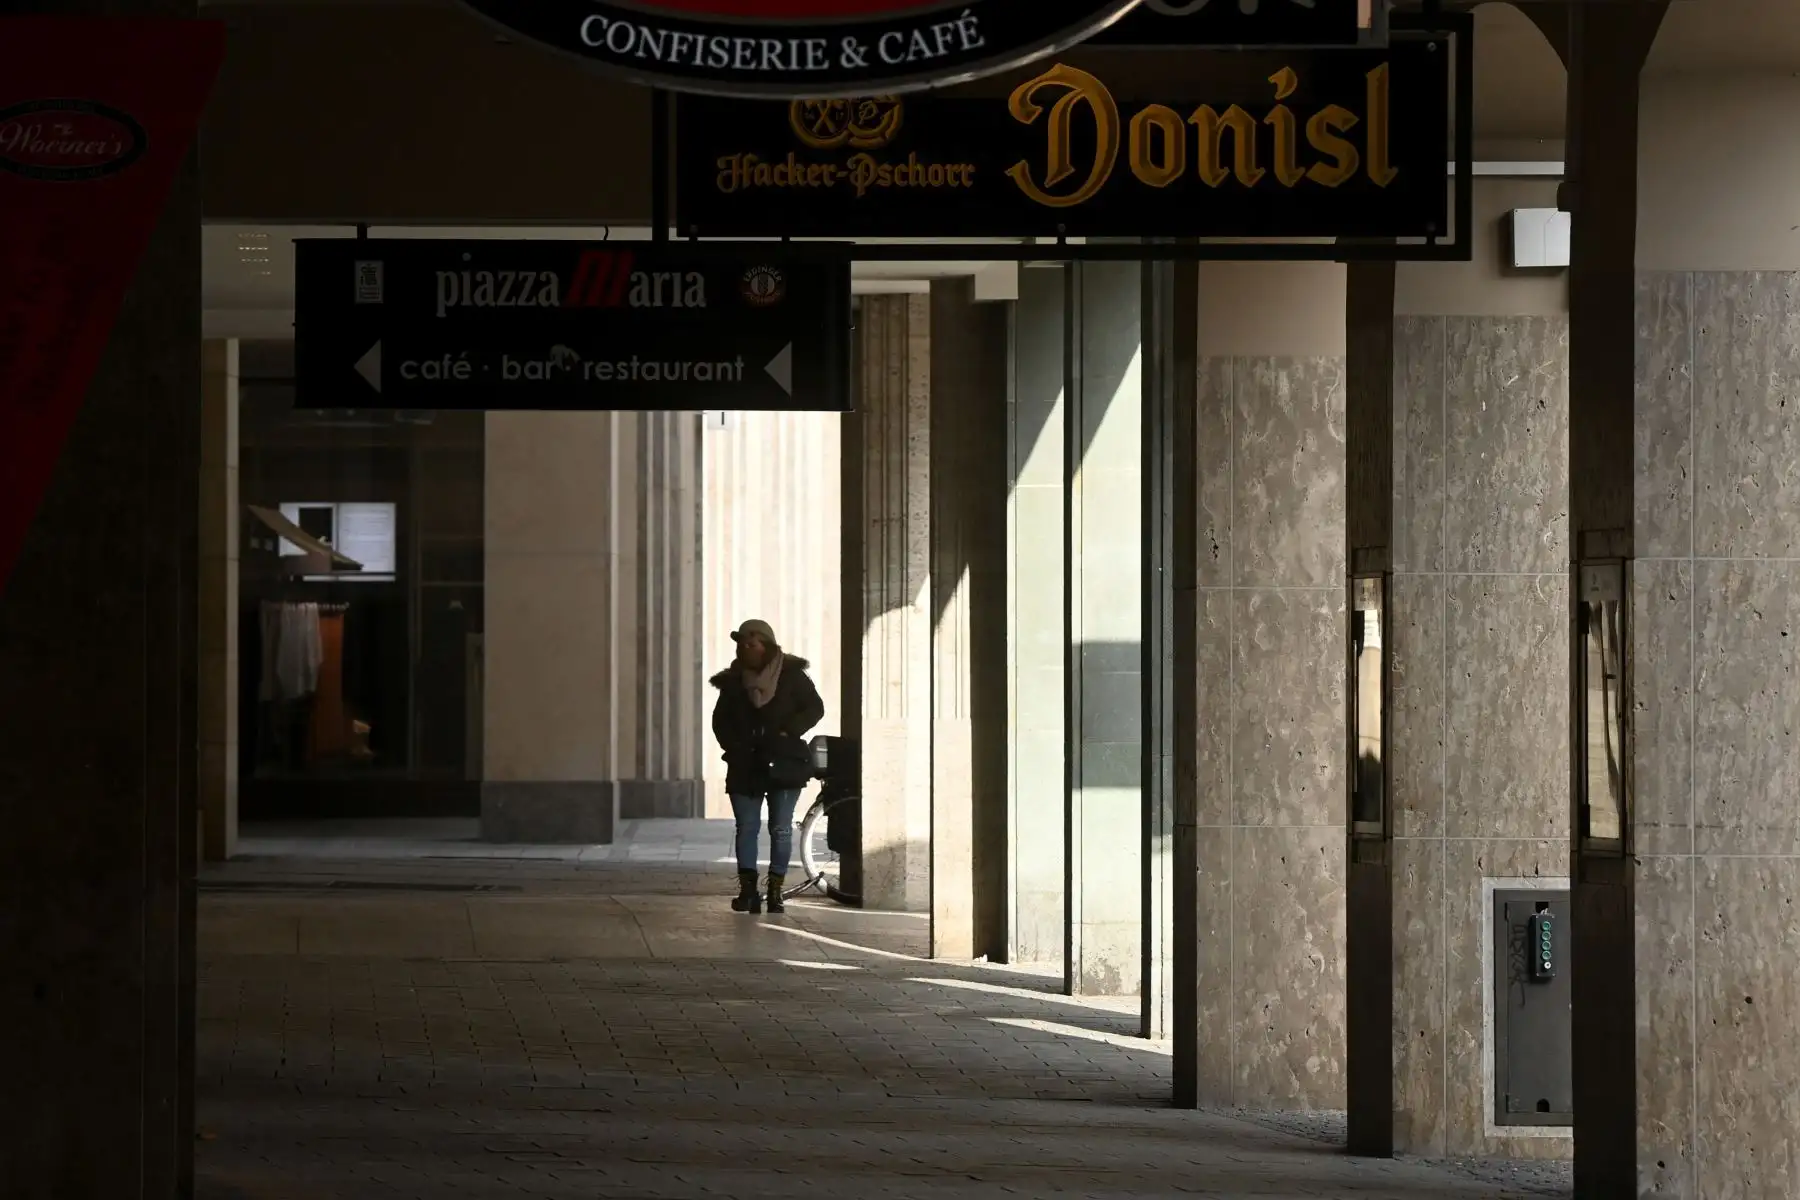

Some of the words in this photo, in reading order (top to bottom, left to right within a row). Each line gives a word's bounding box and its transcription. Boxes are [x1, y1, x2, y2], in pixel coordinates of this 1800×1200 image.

[578, 14, 830, 73] CONFISERIE
[840, 37, 868, 67] &
[877, 9, 987, 66] CAFÉ
[1004, 61, 1399, 208] Donisl
[715, 152, 975, 197] Hacker-Pschorr
[434, 253, 560, 317] piazza
[399, 352, 472, 382] café
[501, 355, 555, 382] bar
[583, 355, 745, 382] restaurant
